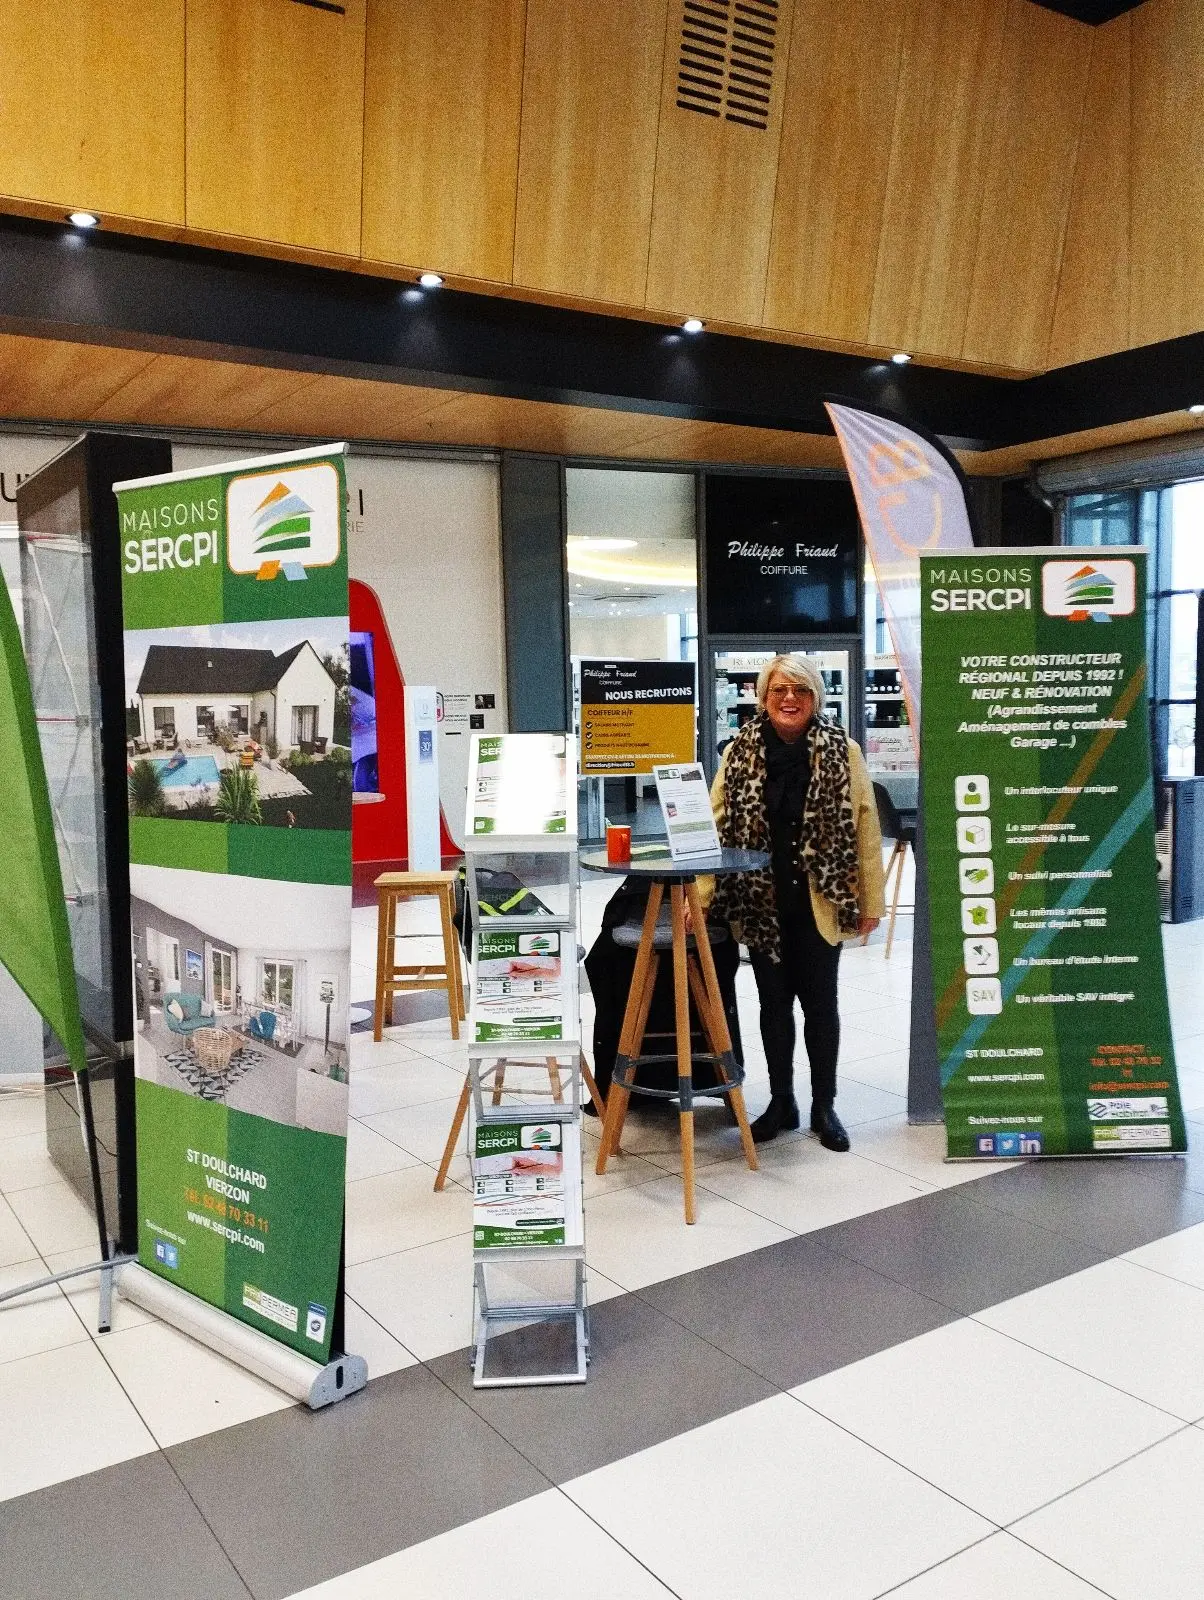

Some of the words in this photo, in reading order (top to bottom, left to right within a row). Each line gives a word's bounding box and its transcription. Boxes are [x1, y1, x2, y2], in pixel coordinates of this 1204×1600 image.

[123, 498, 219, 533] MAISONS
[124, 530, 218, 574] SERCPI
[728, 540, 785, 560] Philippe
[760, 565, 808, 576] COIFFURE
[930, 568, 1032, 584] MAISONS
[930, 588, 1031, 612] SERCPI
[960, 655, 1007, 668] VOTRE
[1009, 653, 1122, 666] CONSTRUCTEUR
[958, 670, 1029, 684] RÉGIONAL
[1032, 670, 1083, 682] DEPUIS
[1086, 670, 1116, 681] 1992
[605, 690, 634, 700] NOUS
[634, 687, 692, 699] RECRUTONS
[971, 687, 1009, 700] NEUF
[1011, 687, 1022, 698] &
[1024, 684, 1112, 698] RÉNOVATION
[622, 708, 633, 717] H/F
[988, 702, 1098, 718] (Agrandissement
[957, 720, 1051, 734] Aménagement
[1053, 719, 1070, 730] de
[1072, 718, 1128, 730] combles
[1010, 736, 1058, 750] Garage
[1004, 786, 1019, 796] Un
[1008, 872, 1023, 880] Un
[1010, 908, 1028, 916] Les
[478, 945, 516, 953] SERCPI
[972, 990, 996, 1002] SAV
[966, 1050, 979, 1058] ST
[980, 1048, 1043, 1058] DOULCHARD
[478, 1130, 518, 1138] MAISONS
[478, 1138, 518, 1148] SERCPI
[186, 1148, 200, 1165] ST
[202, 1153, 267, 1190] DOULCHARD
[206, 1175, 250, 1204] VIERZON
[187, 1210, 265, 1254] www.sercpi.com
